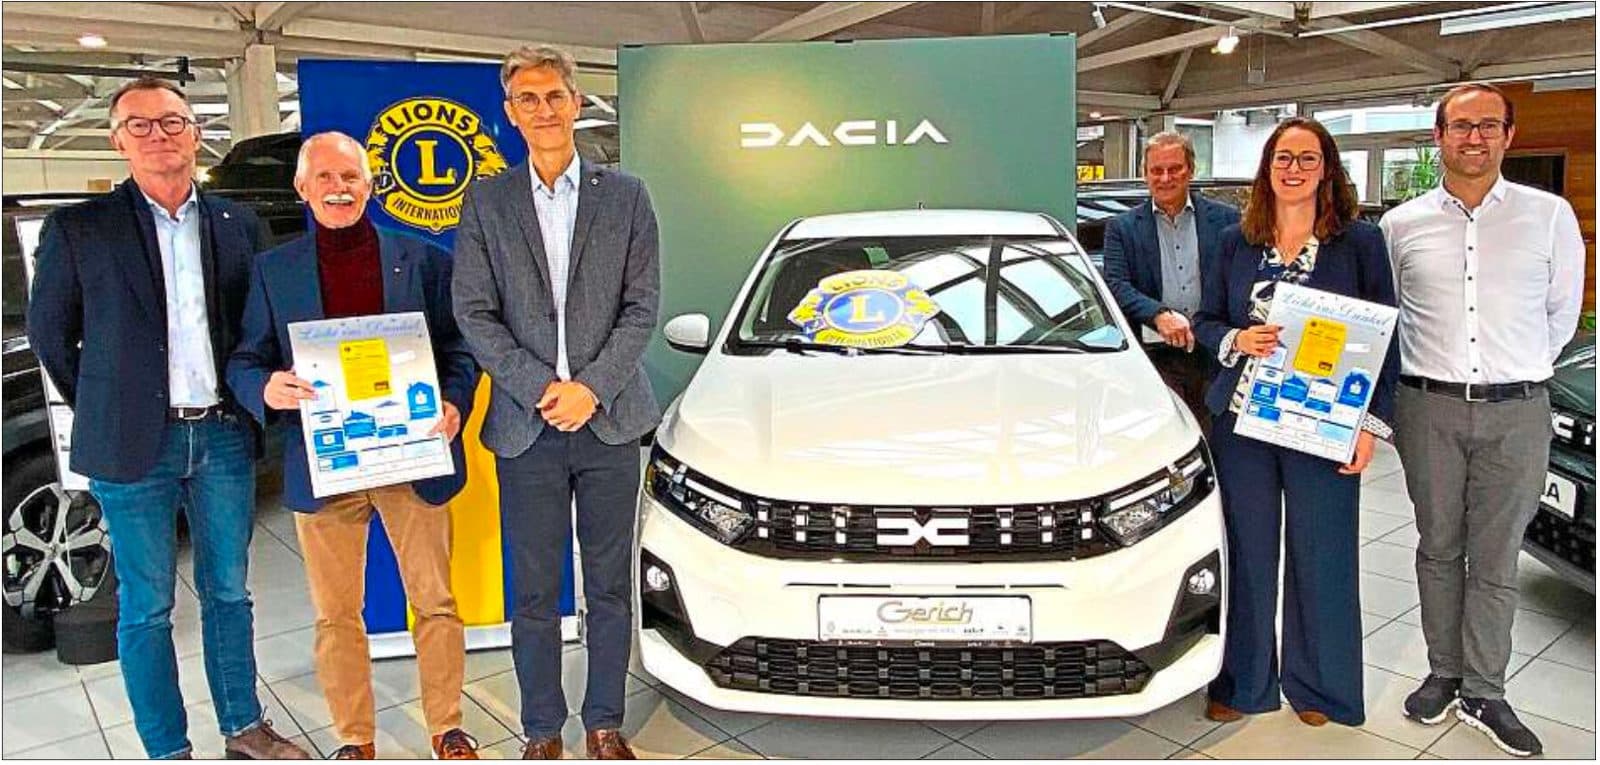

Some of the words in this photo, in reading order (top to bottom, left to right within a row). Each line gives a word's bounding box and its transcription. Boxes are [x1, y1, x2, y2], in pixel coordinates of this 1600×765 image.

[386, 103, 474, 132] LIONS
[740, 119, 949, 148] DACIA
[415, 139, 456, 185] L
[849, 297, 884, 323] L
[877, 601, 974, 624] Gerich
